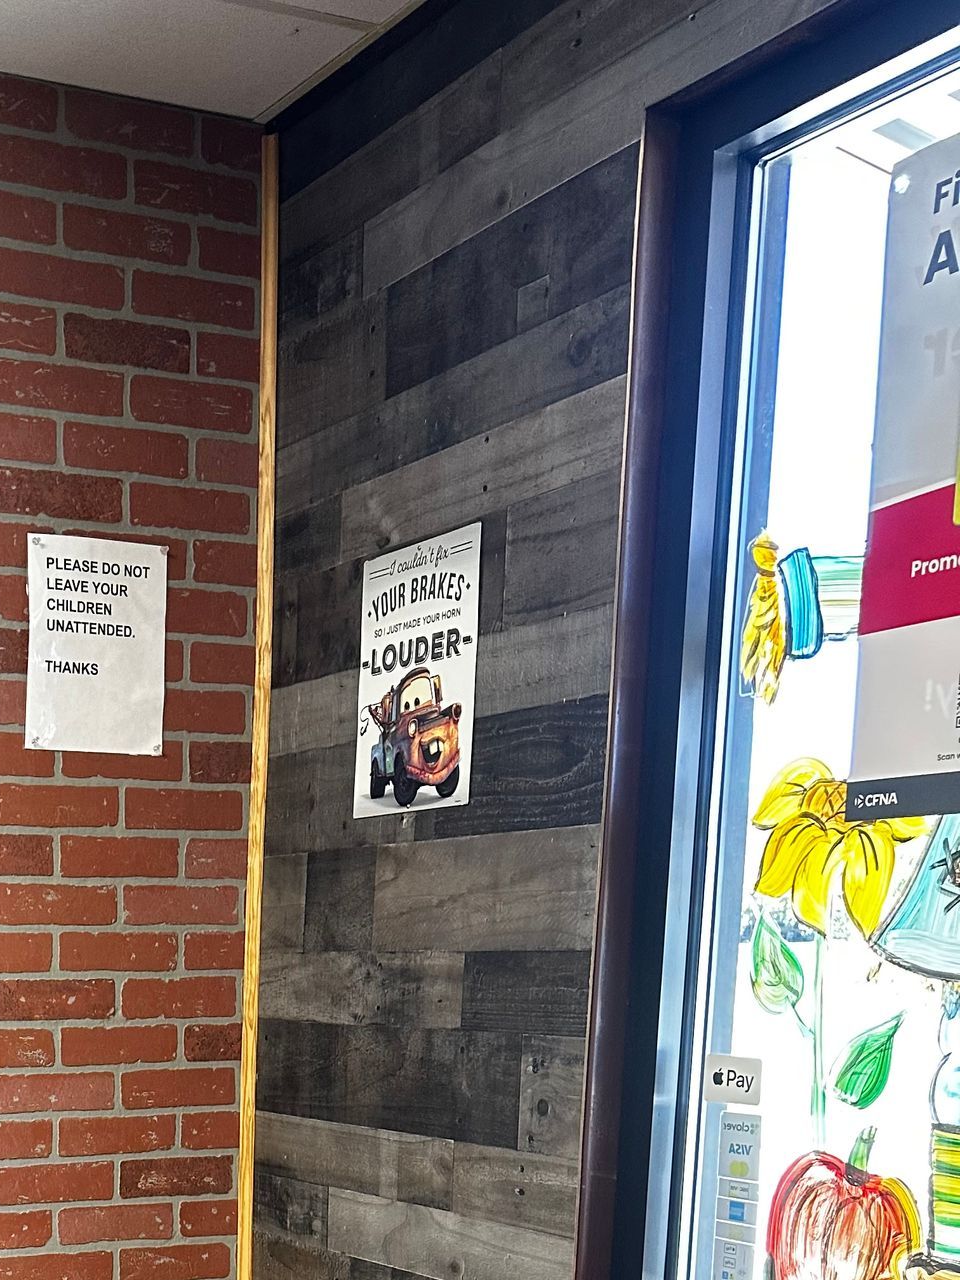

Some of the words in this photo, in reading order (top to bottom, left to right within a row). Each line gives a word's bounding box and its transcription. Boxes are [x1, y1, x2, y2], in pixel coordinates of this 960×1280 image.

[434, 545, 450, 568] fix
[46, 557, 99, 573] PLEASE
[102, 562, 121, 576] DO
[124, 564, 150, 578] NOT
[46, 577, 89, 593] LEAVE
[92, 581, 128, 597] YOUR
[372, 582, 406, 622] YOUR
[410, 572, 465, 604] BRAKES
[46, 598, 112, 615] CHILDREN
[46, 618, 135, 638] UNATTENDED.
[374, 628, 383, 638] SO
[386, 622, 402, 635] JUST
[402, 618, 421, 630] MADE
[422, 612, 440, 626] YOUR
[441, 607, 461, 619] HORN
[45, 659, 99, 675] THANKS
[937, 753, 955, 761] Scan
[865, 792, 898, 807] CFNA
[727, 1070, 755, 1093] Pay
